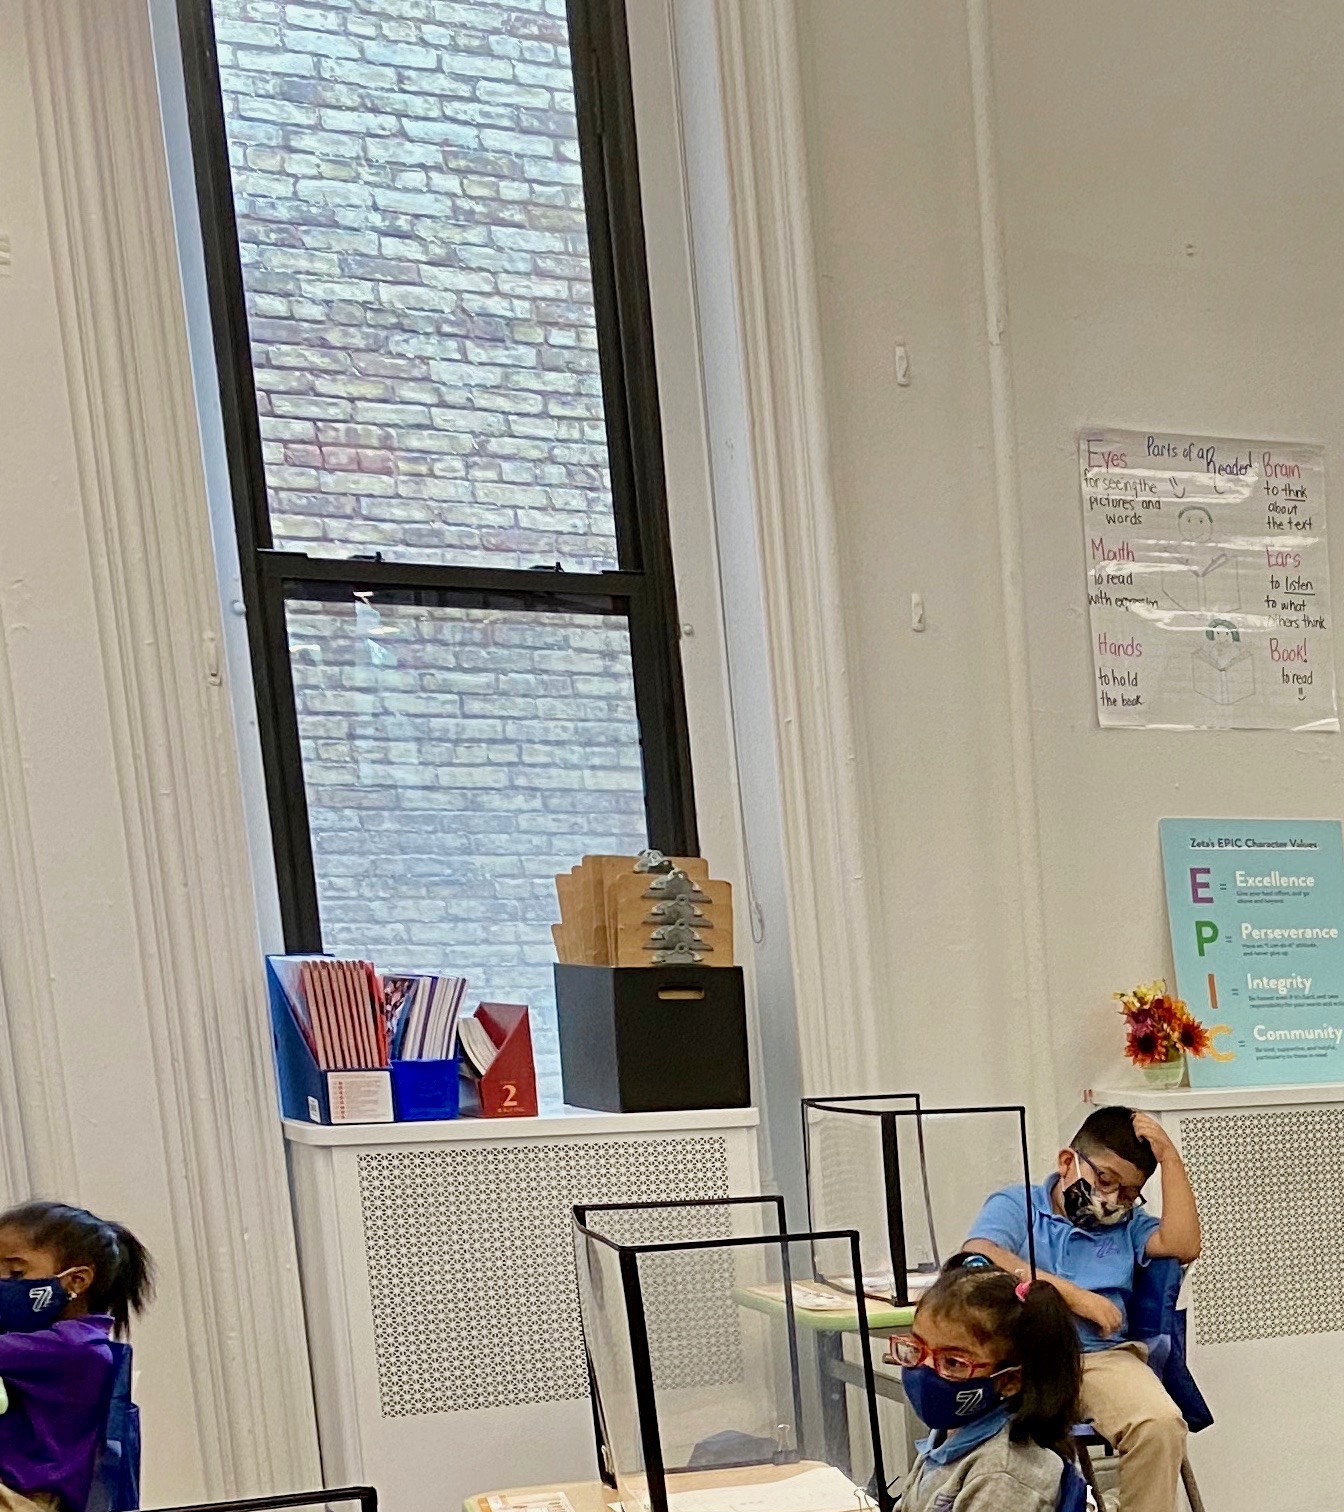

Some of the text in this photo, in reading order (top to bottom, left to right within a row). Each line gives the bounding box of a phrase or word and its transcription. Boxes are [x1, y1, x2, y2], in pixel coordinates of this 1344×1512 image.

[1087, 439, 1128, 468] Eyes
[1147, 436, 1178, 459] Parts
[1183, 442, 1194, 461] of
[1262, 452, 1301, 478] Brain
[1264, 484, 1279, 496] to
[1142, 497, 1161, 510] and
[1268, 501, 1298, 515] about
[1106, 512, 1142, 525] words
[1267, 516, 1312, 530] the text
[1266, 546, 1301, 569] Ears
[1106, 572, 1133, 585] read
[1270, 576, 1314, 591] to listen
[1265, 597, 1306, 612] to what
[1098, 632, 1142, 657] Hands
[1098, 667, 1138, 687] to hold
[1282, 670, 1313, 685] to read
[1101, 693, 1117, 707] the
[1217, 838, 1242, 848] EPIC
[1244, 838, 1287, 849] Character
[1189, 867, 1214, 904] E
[1235, 871, 1315, 888] Excellence
[1195, 920, 1219, 957] P
[1241, 923, 1339, 941] Perseverance
[1208, 973, 1218, 1009] I
[1247, 972, 1313, 995] Integrity
[1208, 1023, 1237, 1062] C
[1253, 1023, 1343, 1044] Community
[502, 1084, 518, 1107] 2
